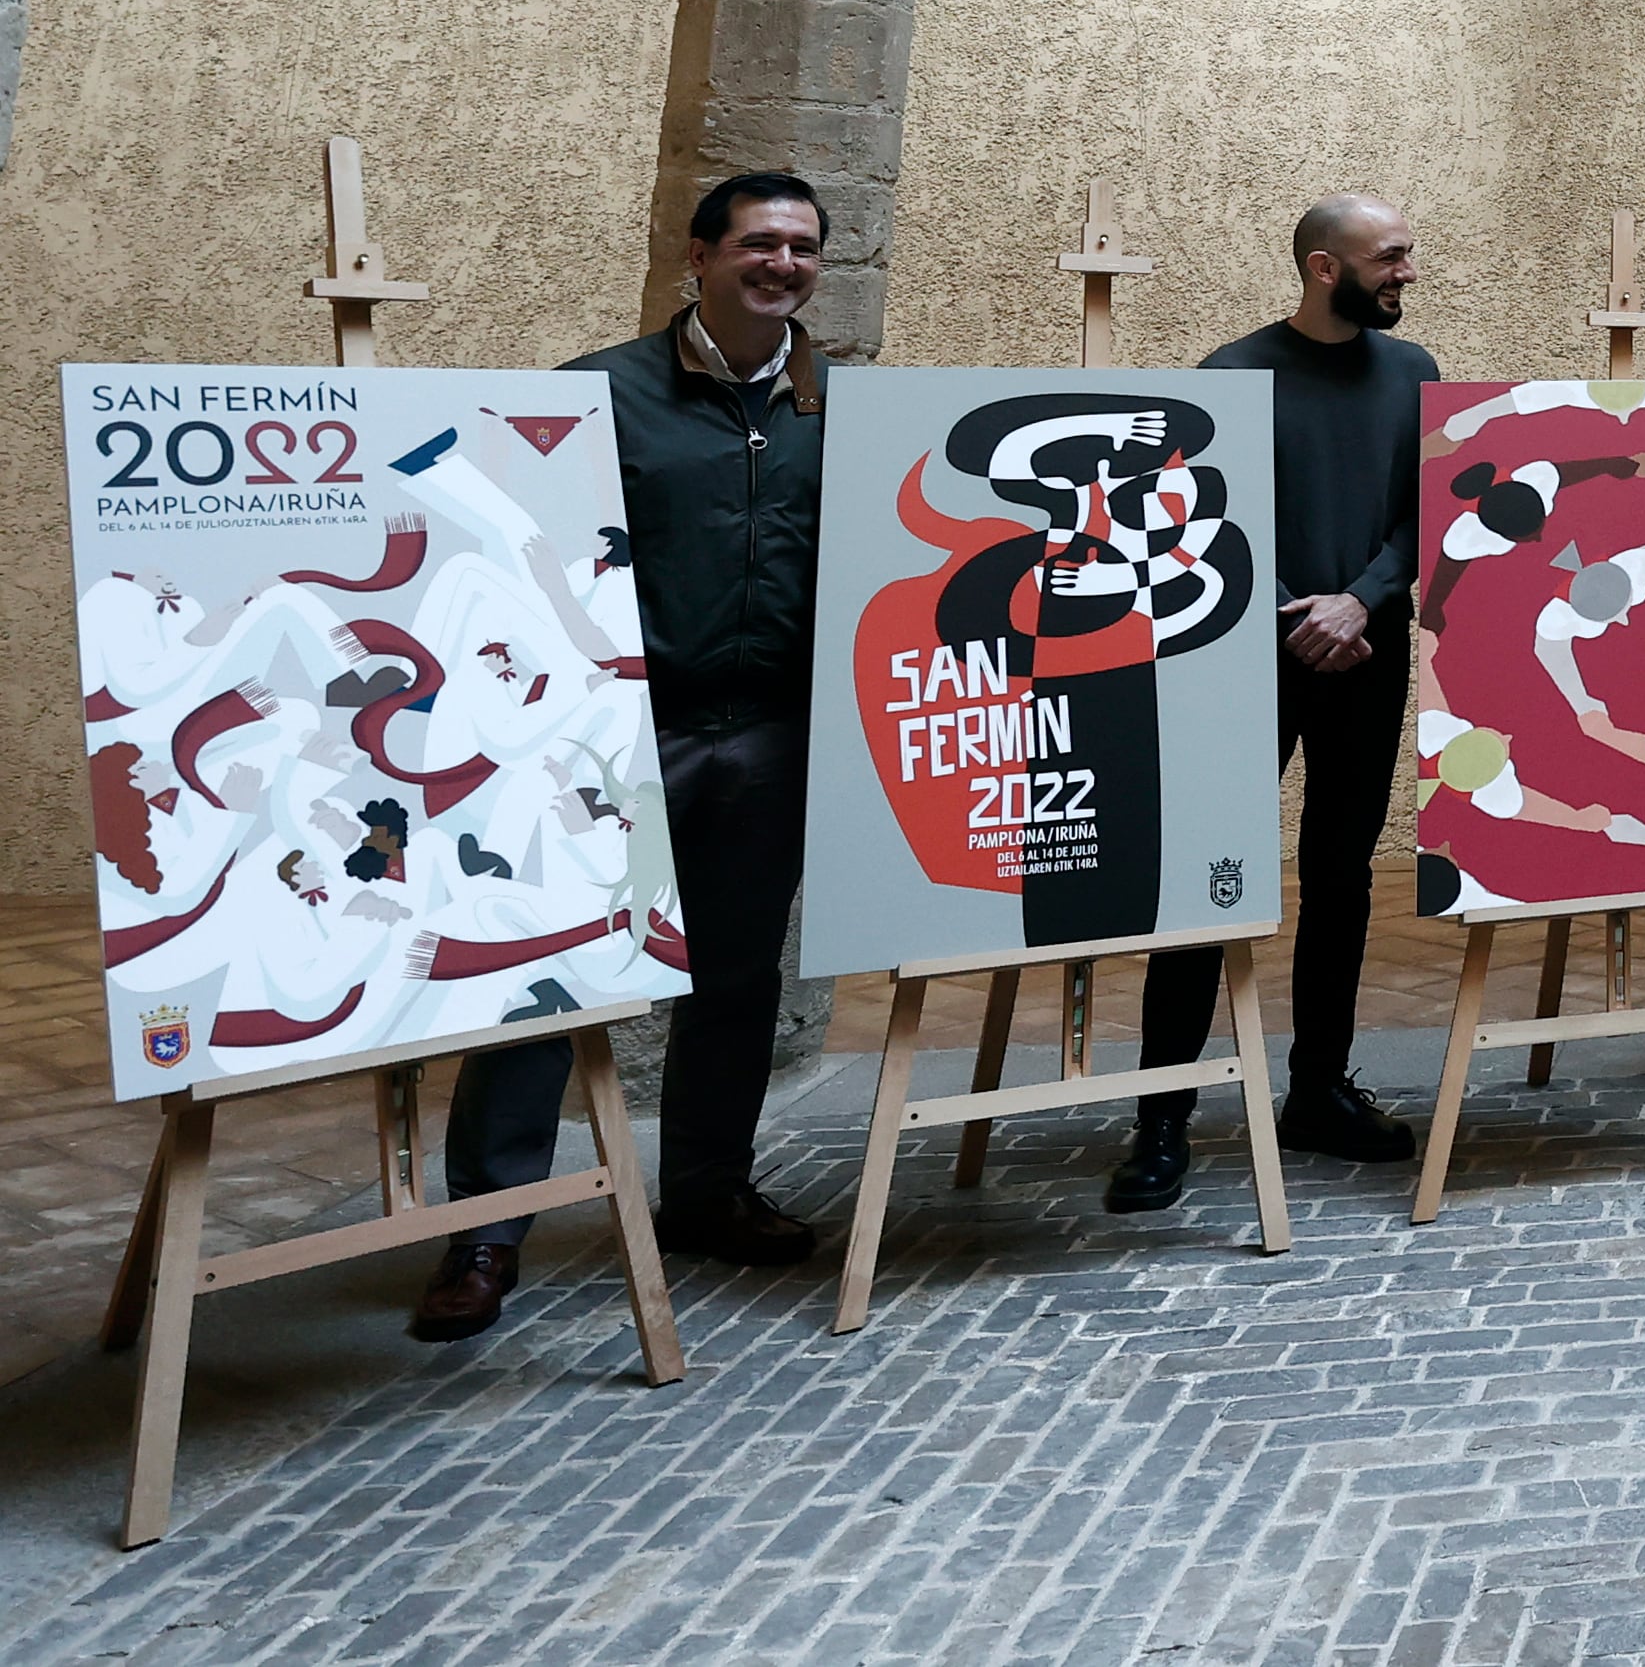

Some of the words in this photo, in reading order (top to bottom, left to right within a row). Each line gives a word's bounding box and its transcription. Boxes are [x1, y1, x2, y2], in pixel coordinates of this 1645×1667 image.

[92, 385, 181, 412] SAN
[200, 381, 358, 412] FERMÍN
[96, 420, 363, 488] 2022
[99, 522, 124, 532] DEL
[128, 523, 136, 531] 6
[140, 521, 156, 531] AL
[160, 521, 171, 530] 14
[175, 520, 192, 530] DE
[314, 515, 339, 526] 6TIK
[342, 515, 368, 524] 14RA
[886, 637, 1009, 713] SAN
[899, 690, 1072, 782] FERMÍN
[968, 769, 1096, 829] 2022
[997, 851, 1016, 864] DEL
[1018, 850, 1025, 862] 6
[1026, 849, 1040, 861] AL
[1042, 848, 1053, 859] 14
[1055, 846, 1069, 858] DE
[1070, 843, 1098, 857] JULIO
[997, 861, 1052, 878] UZTAILAREN
[1054, 859, 1073, 872] 6TIK
[1076, 857, 1098, 870] 14RA
